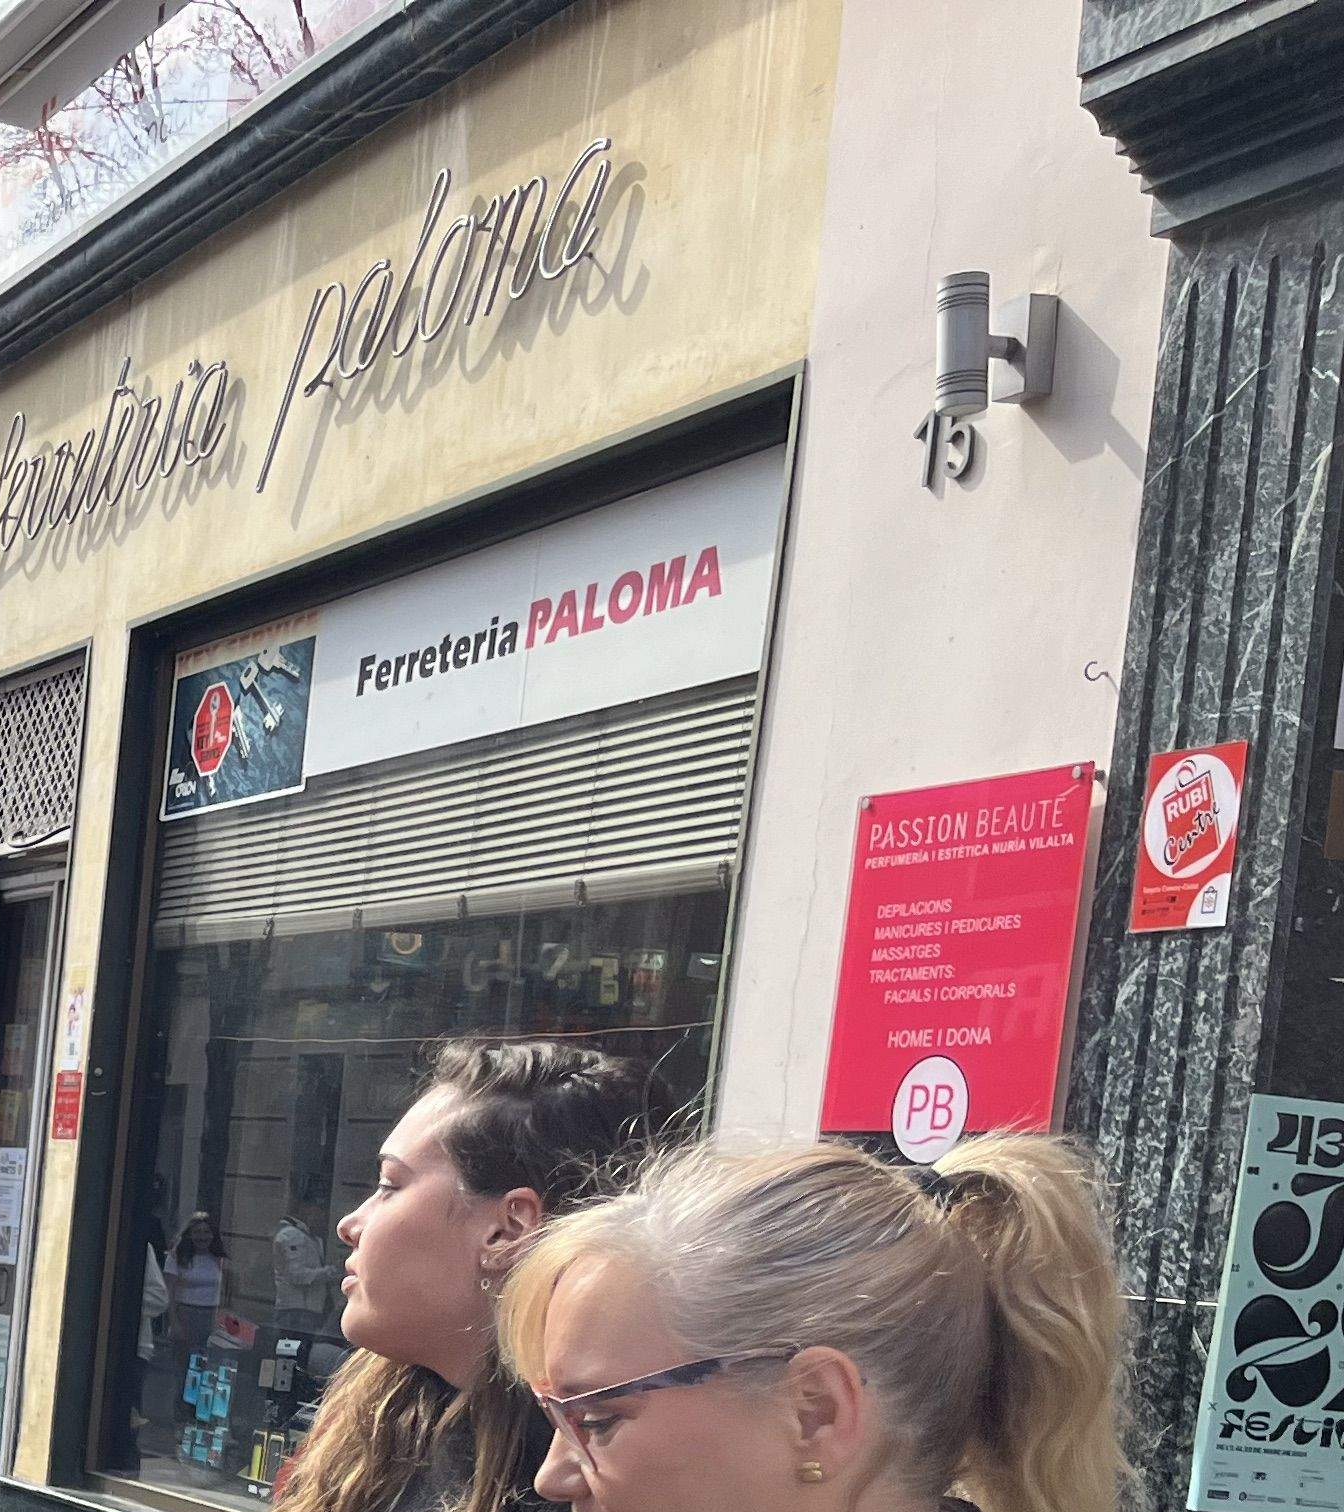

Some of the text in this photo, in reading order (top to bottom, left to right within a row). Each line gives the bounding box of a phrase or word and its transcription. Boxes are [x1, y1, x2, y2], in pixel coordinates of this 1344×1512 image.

[256, 137, 611, 494] paloma
[355, 545, 722, 698] Ferreteria PALOMA
[1167, 778, 1210, 822] RUBÍ
[869, 811, 968, 852] PASSION
[1029, 832, 1075, 850] VILALTA
[877, 899, 952, 920] DEPILACIONS
[874, 921, 943, 940] MANICURES
[951, 914, 1022, 934] PEDICURES
[871, 943, 941, 962] MASSATGES
[884, 988, 931, 1004] FACIALS
[940, 983, 1016, 1001] CORPORALS
[887, 1027, 992, 1048] HOME I DONA
[904, 1083, 956, 1131] PB
